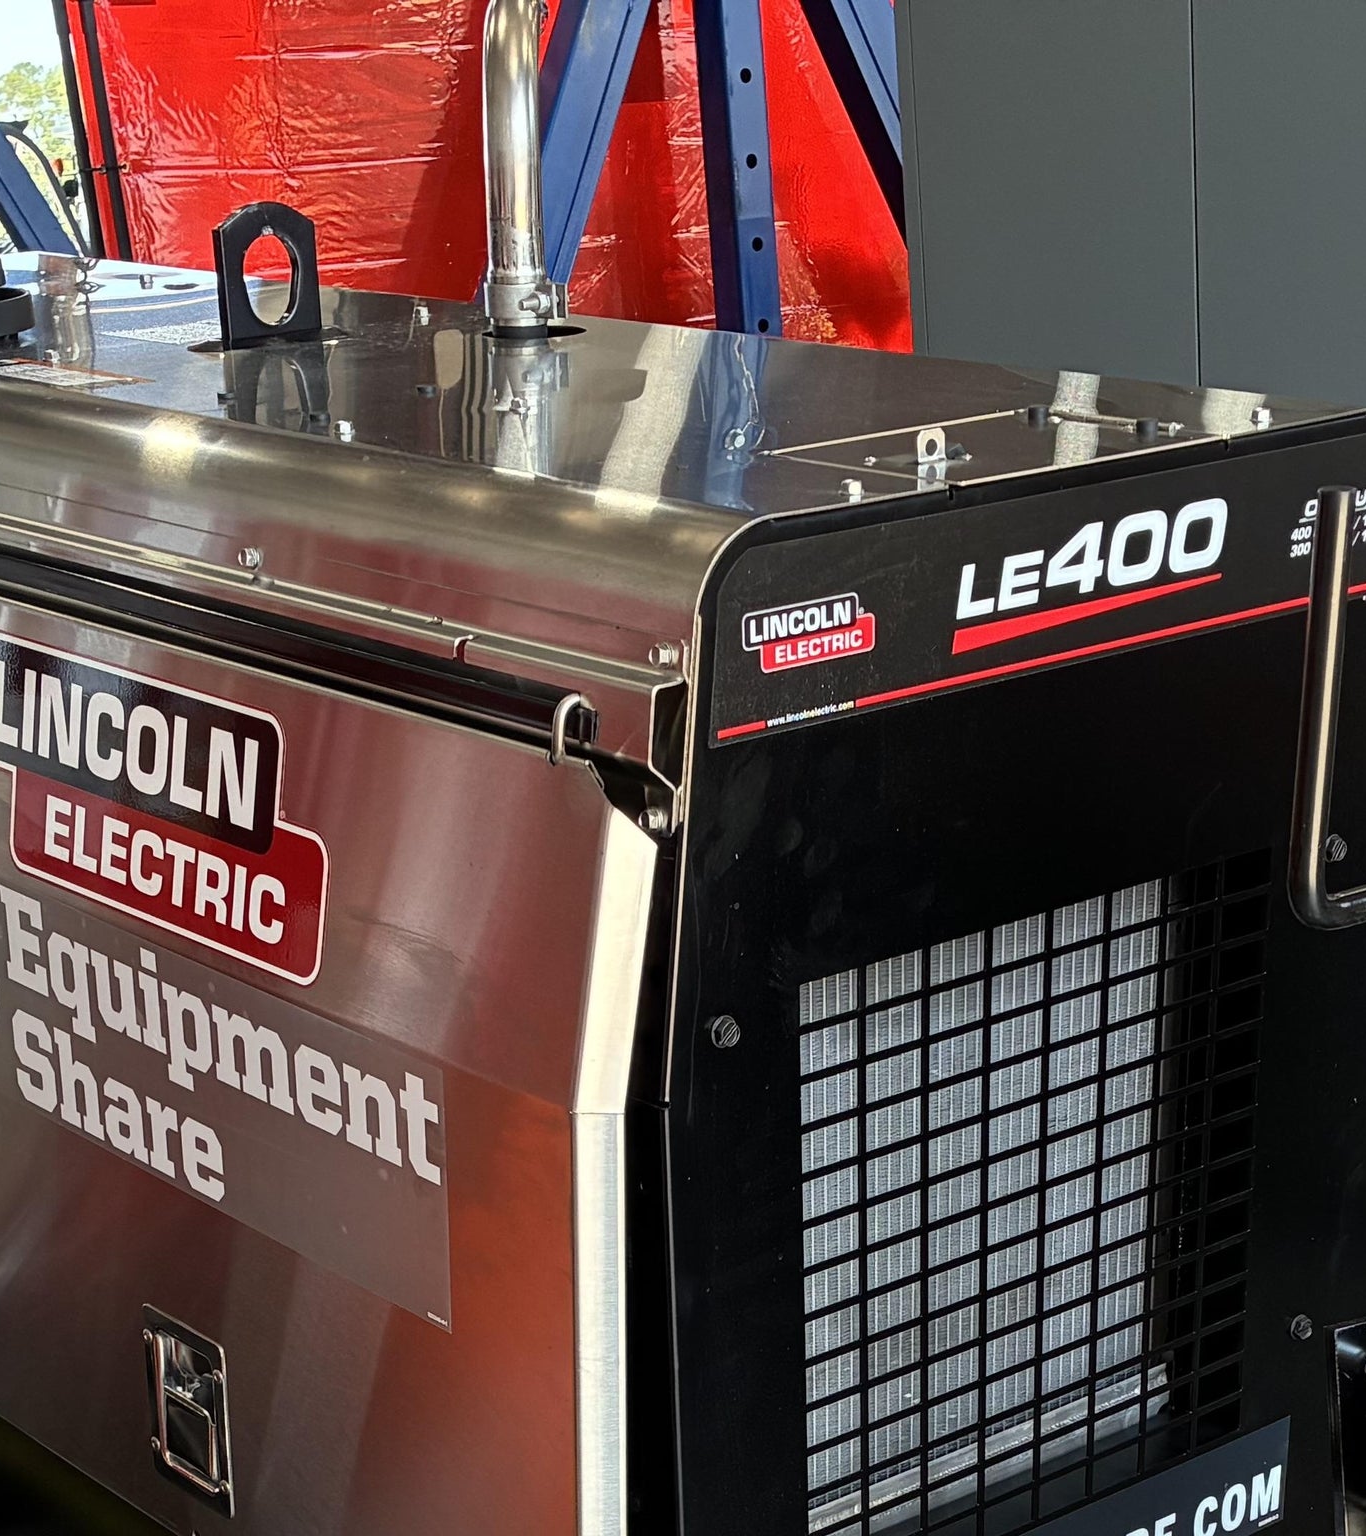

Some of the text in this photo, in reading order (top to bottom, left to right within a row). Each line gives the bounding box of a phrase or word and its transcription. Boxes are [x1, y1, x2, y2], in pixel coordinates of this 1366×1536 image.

[1290, 541, 1311, 558] 300
[1291, 526, 1312, 541] 400
[955, 497, 1228, 620] LE400
[749, 600, 851, 644] LINCOLN
[775, 629, 863, 664] ELECTRIC
[767, 700, 854, 727] www.lincolnelectric.com
[43, 798, 287, 945] ELECTRIC
[11, 1010, 227, 1203] Share
